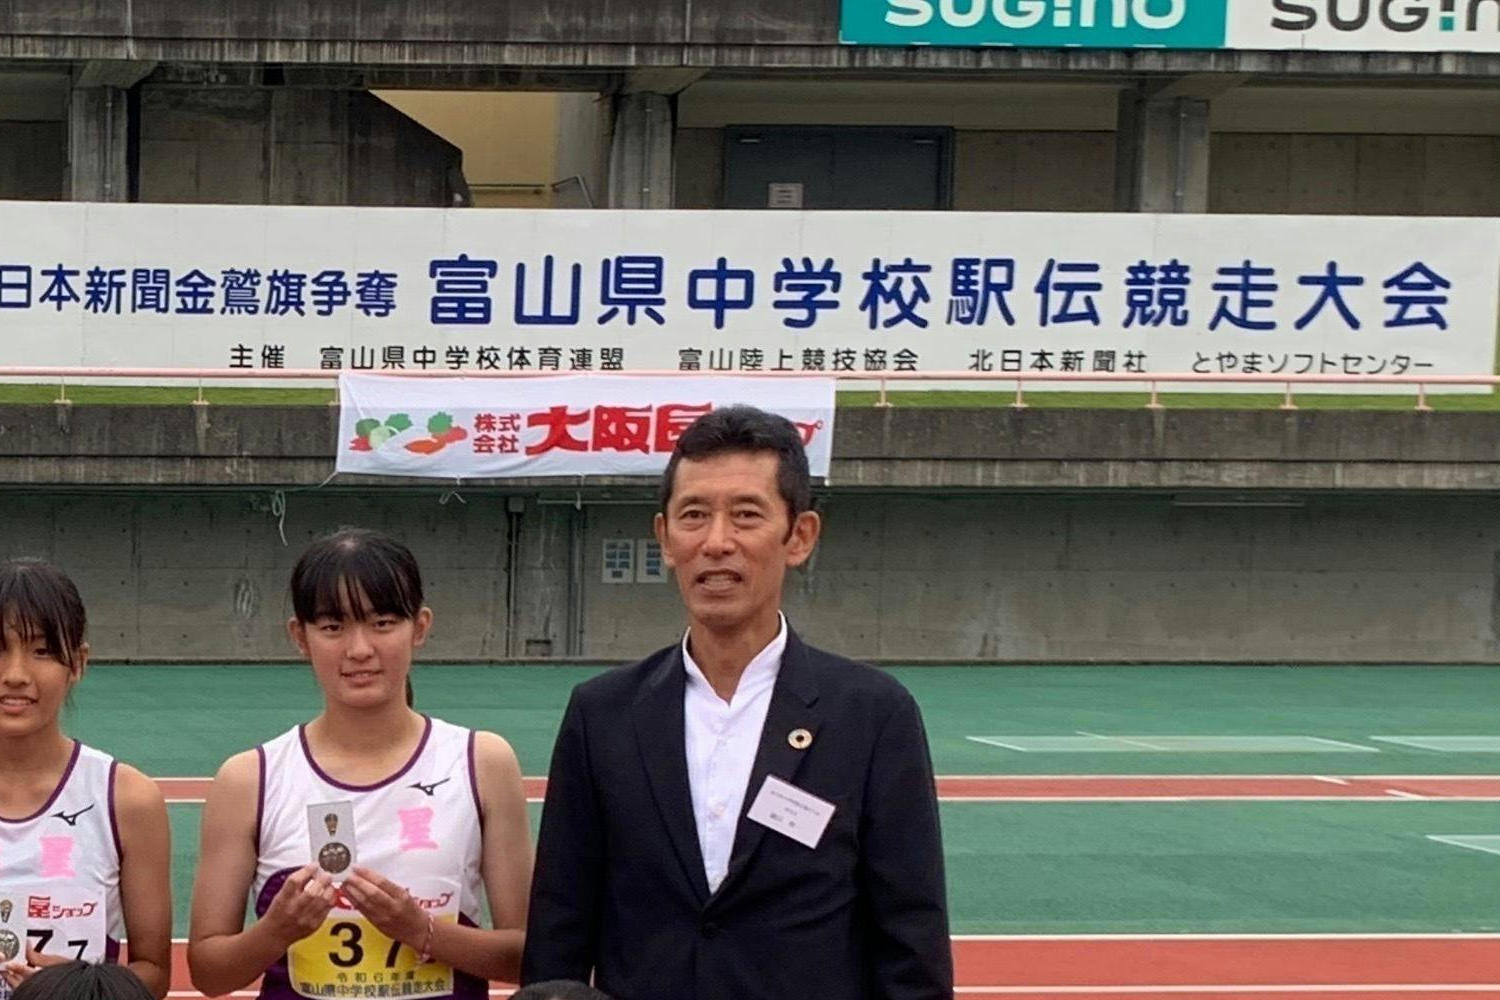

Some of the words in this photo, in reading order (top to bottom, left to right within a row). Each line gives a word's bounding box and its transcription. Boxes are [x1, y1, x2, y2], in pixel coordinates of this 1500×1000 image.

[429, 253, 1451, 331] 富山県中学校駅伝競走大会
[229, 344, 285, 370] 主催
[320, 345, 624, 371] 富山県中学校体育連盟
[679, 346, 918, 373] 富山陸上競技協会
[968, 349, 1147, 373] 北日本新聞社
[1192, 350, 1433, 375] とやまソフトセンター
